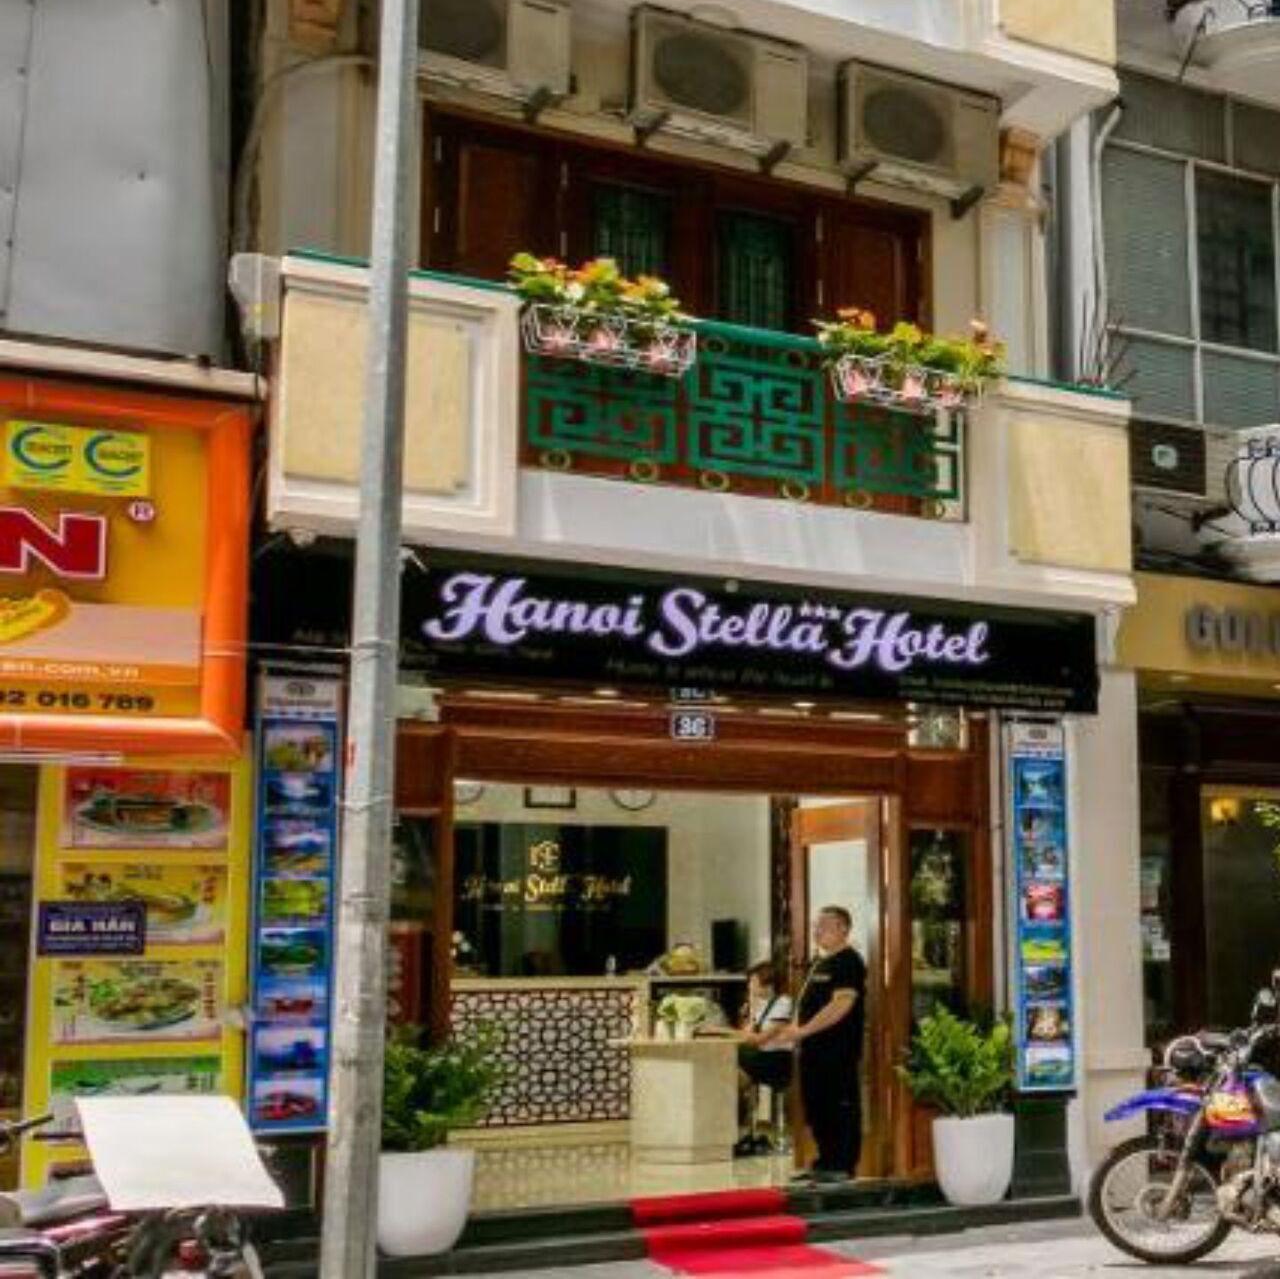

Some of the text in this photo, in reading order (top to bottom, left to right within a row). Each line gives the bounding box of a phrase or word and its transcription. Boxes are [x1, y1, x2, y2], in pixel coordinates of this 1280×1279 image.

[422, 572, 990, 671] Hanoi Stella Hotel
